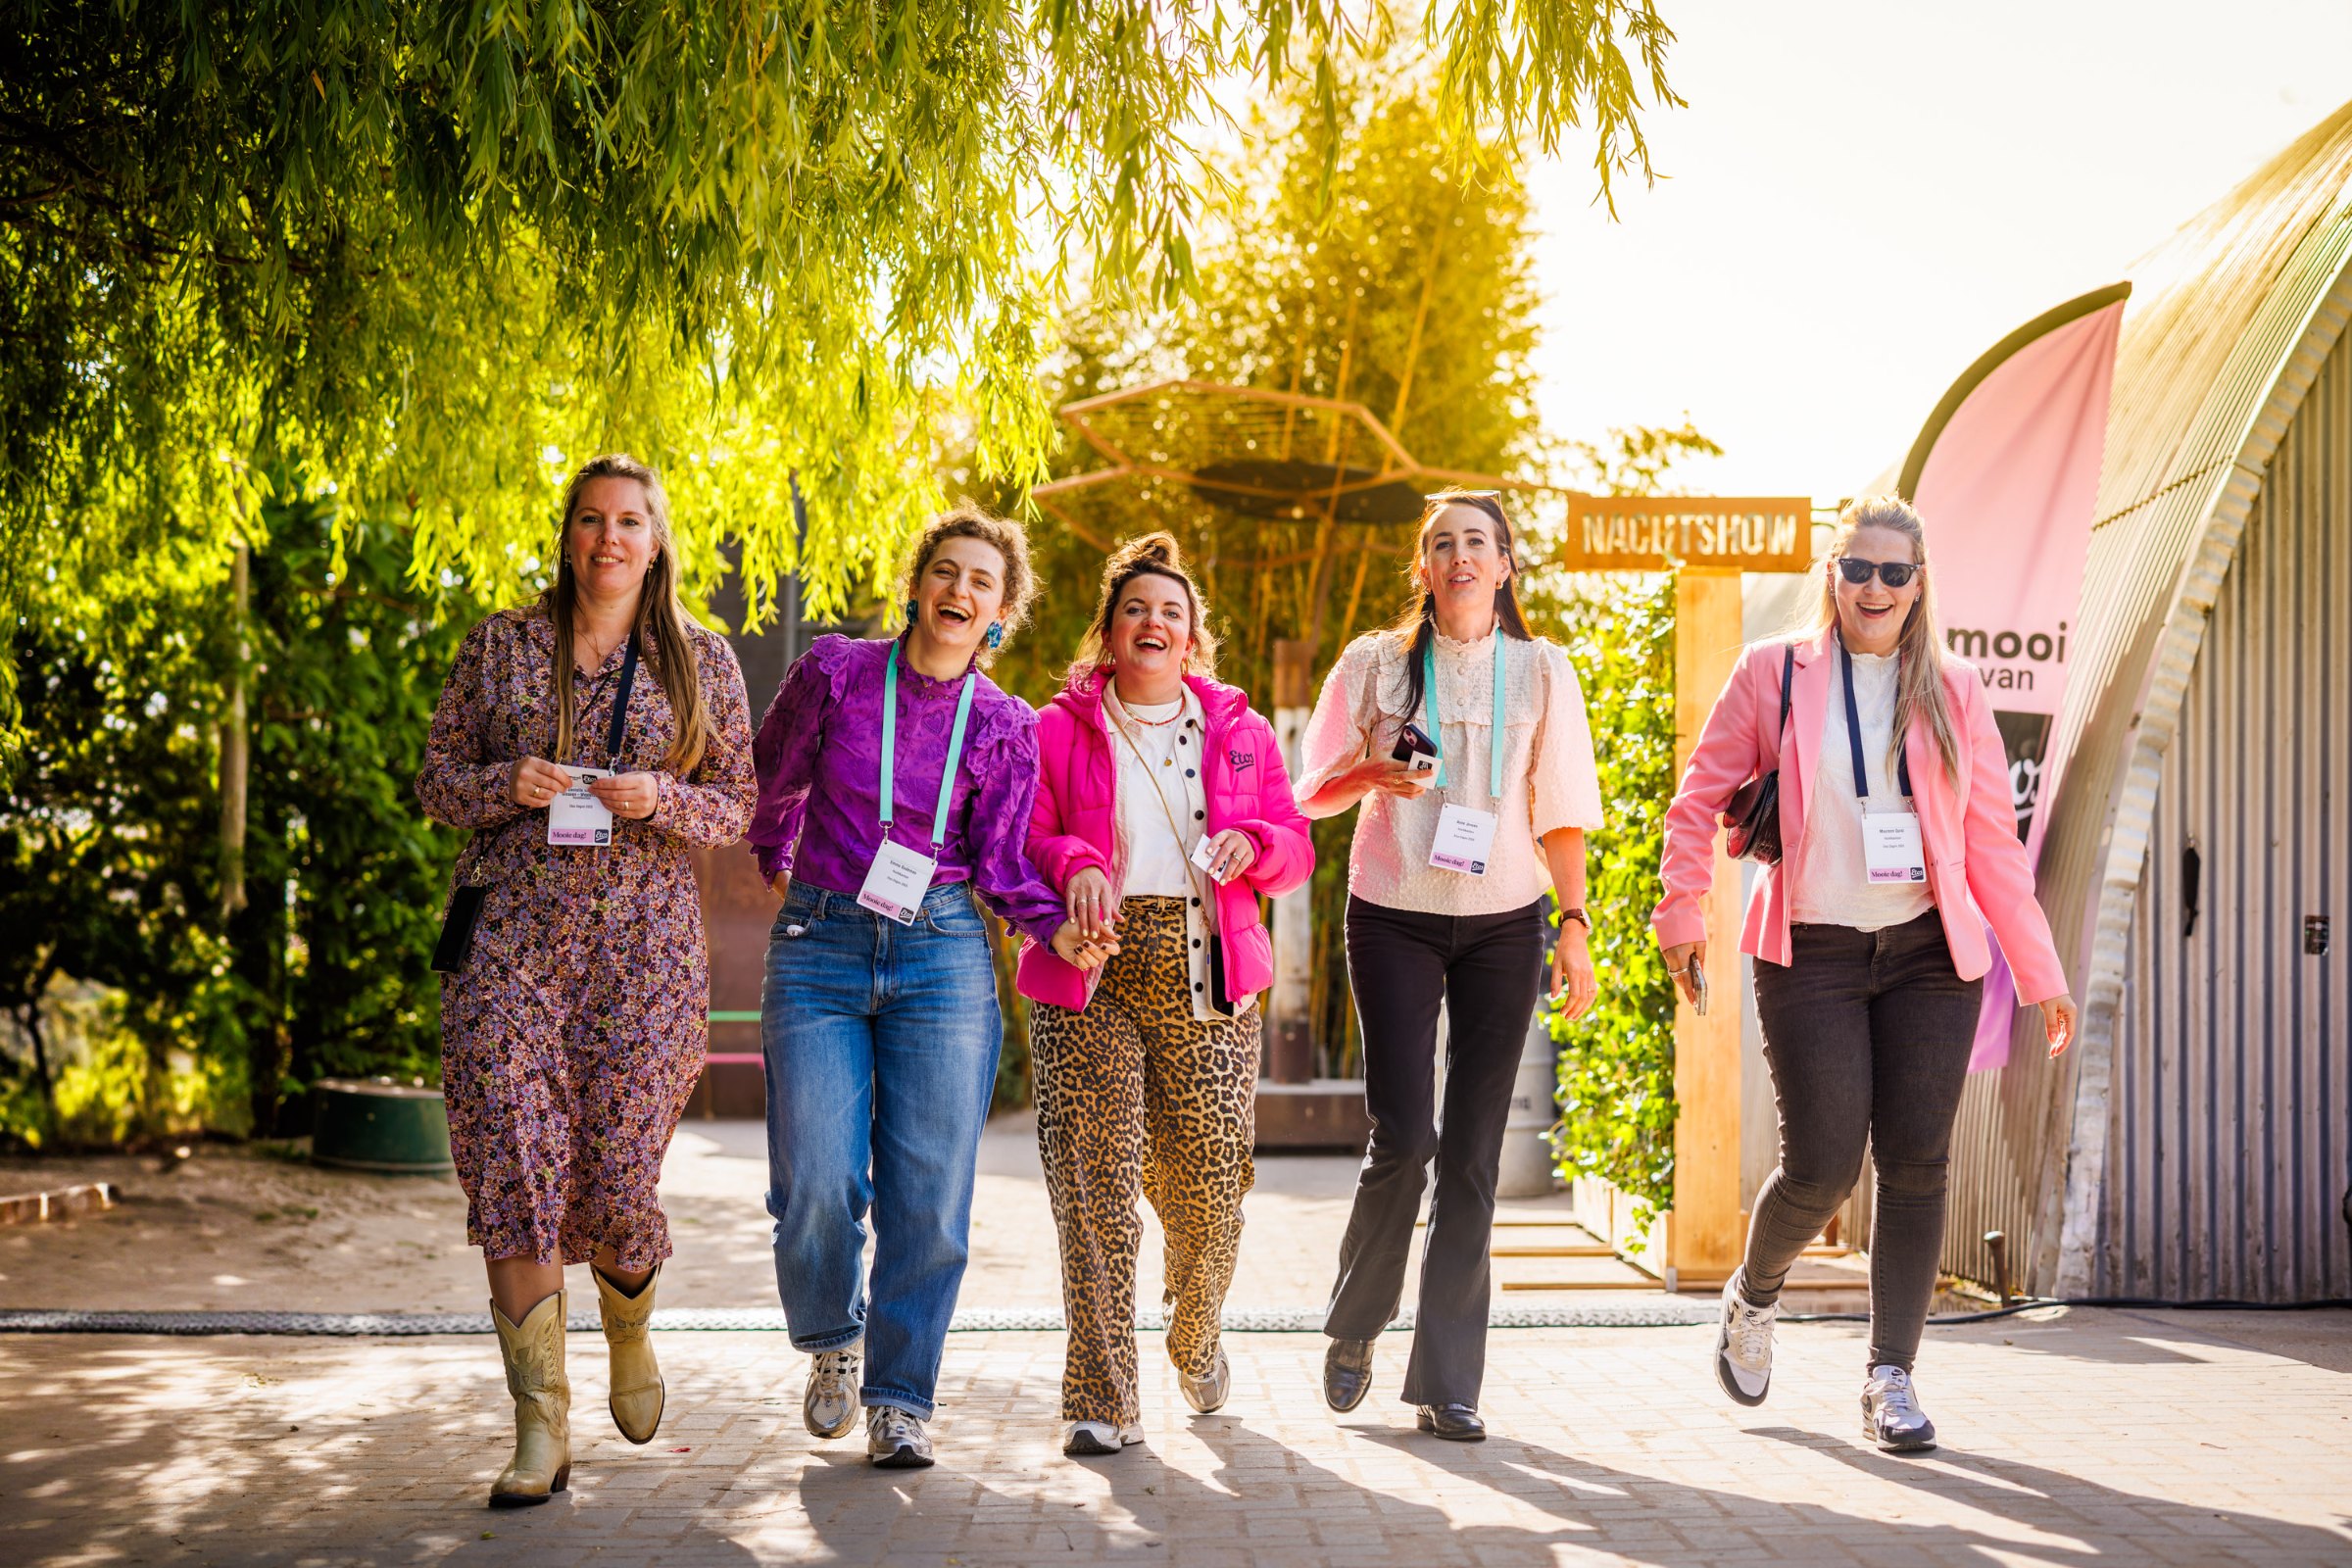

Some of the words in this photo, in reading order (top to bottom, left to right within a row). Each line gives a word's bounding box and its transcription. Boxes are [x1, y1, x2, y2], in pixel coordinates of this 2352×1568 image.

[1581, 513, 1797, 556] NACHTSHOW
[1947, 621, 2067, 663] mooi
[1981, 667, 2034, 691] van
[1229, 750, 1254, 767] Etos
[573, 831, 587, 840] dag!
[1434, 855, 1451, 864] Mooie
[862, 893, 880, 906] Mooie
[880, 901, 894, 911] dag!
